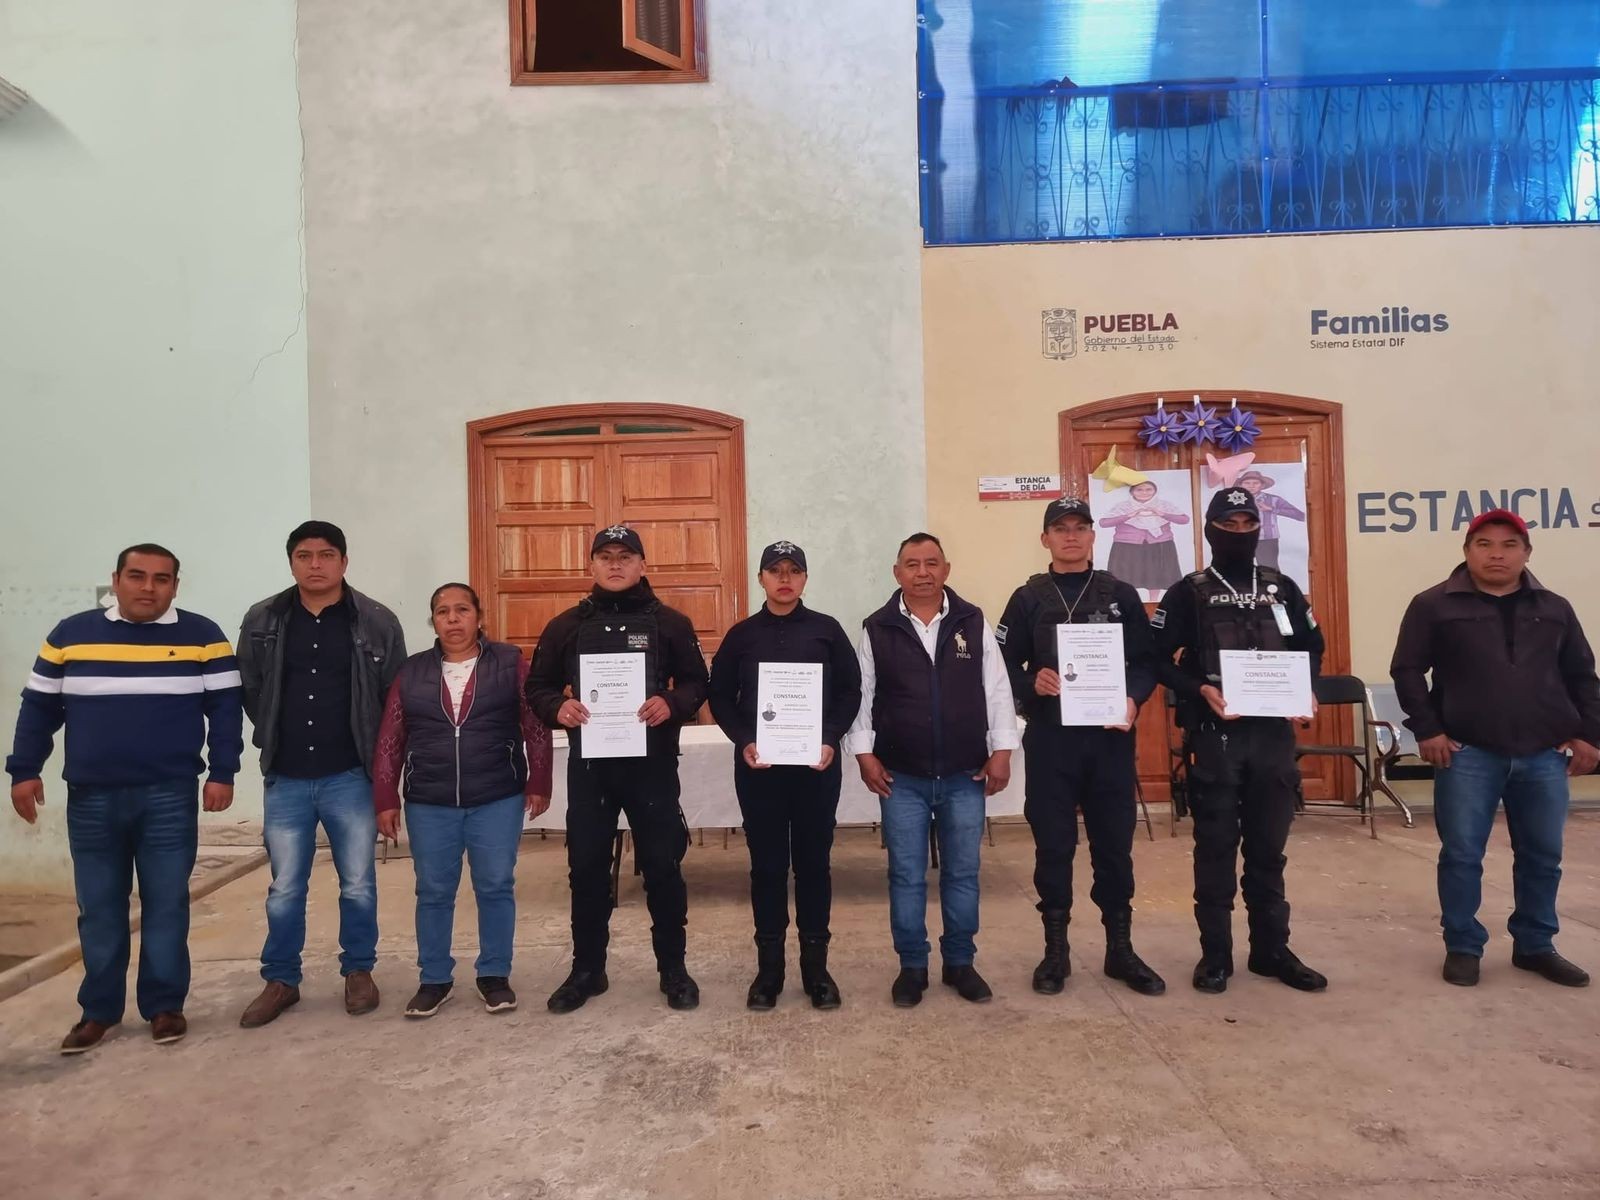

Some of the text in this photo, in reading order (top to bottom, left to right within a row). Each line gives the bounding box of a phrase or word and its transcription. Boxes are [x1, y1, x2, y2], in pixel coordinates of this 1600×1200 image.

[1084, 313, 1179, 334] PUEBLA
[1311, 306, 1449, 335] Familias
[1084, 334, 1175, 344] Gobierno del Estado
[1310, 338, 1405, 349] Sistema Estatal DIF
[1244, 671, 1288, 679] CONSTANCIA
